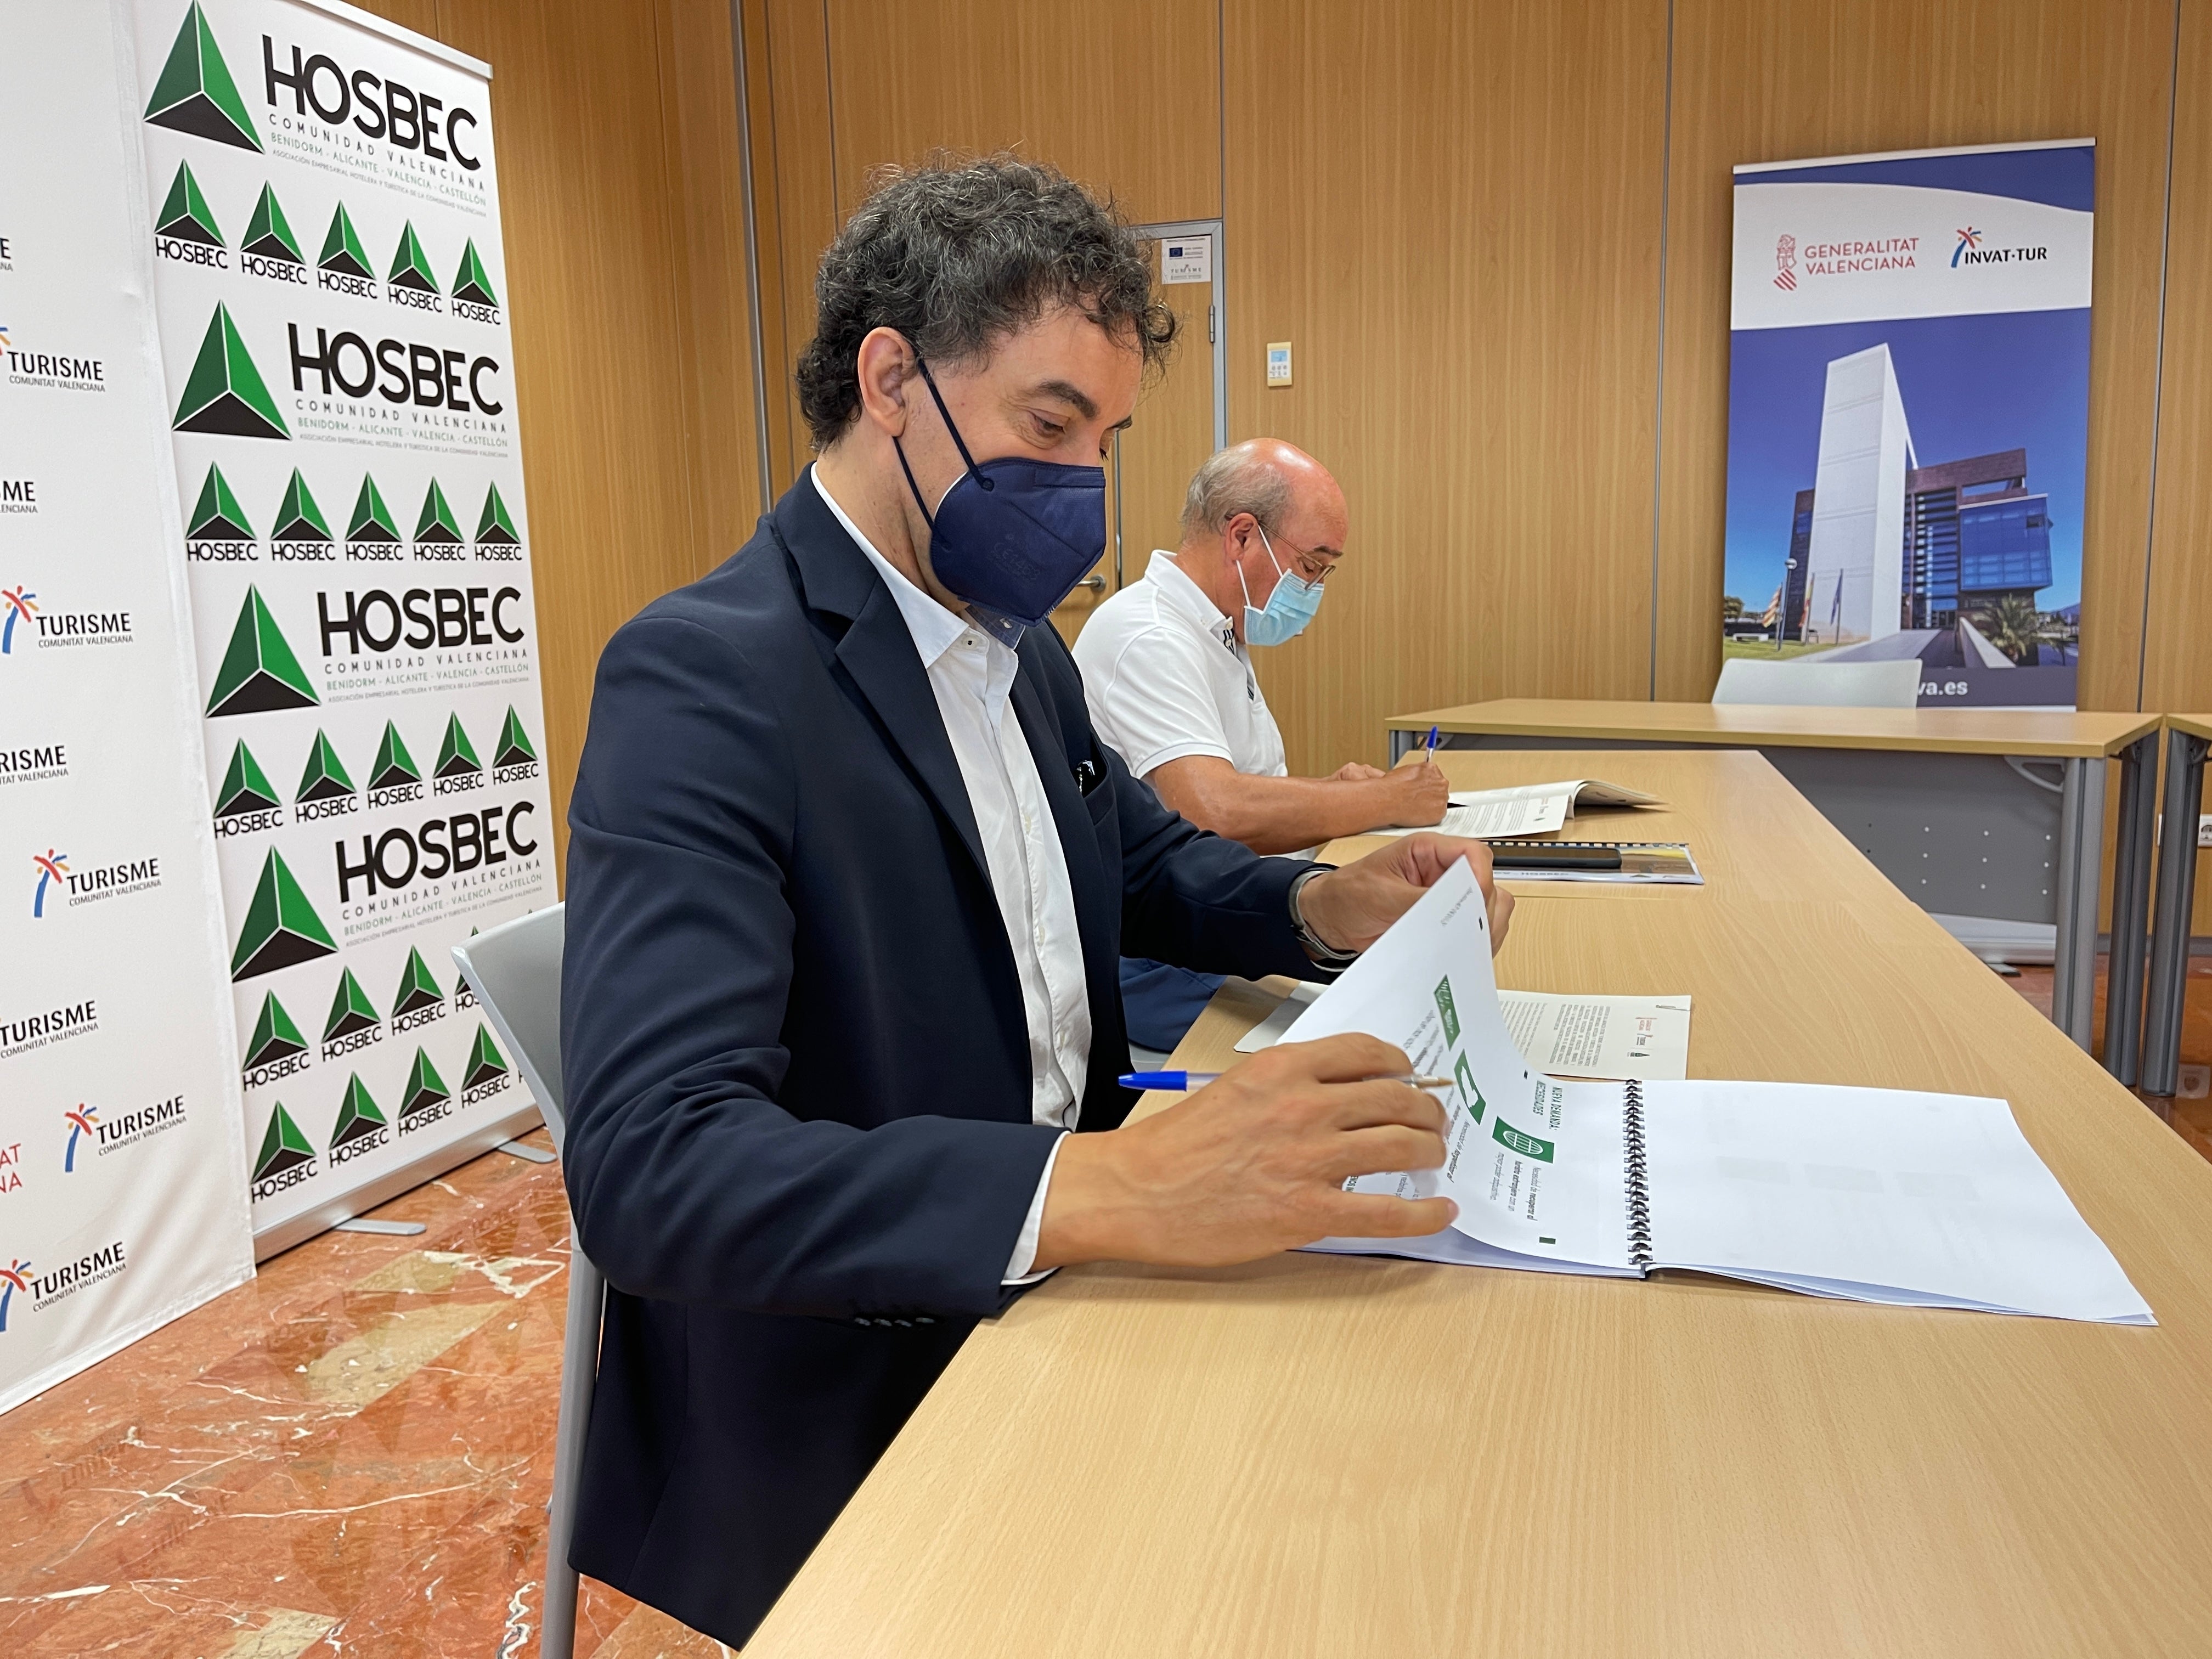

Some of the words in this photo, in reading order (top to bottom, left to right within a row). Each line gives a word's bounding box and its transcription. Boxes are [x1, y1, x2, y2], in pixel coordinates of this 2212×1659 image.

[262, 34, 481, 171] HOSBEC
[269, 114, 374, 155] COMUNIDAD
[387, 150, 484, 191] VALENCIANA
[271, 132, 323, 156] BENIDORM
[333, 151, 379, 173] ALICANTE
[387, 168, 431, 189] VALENCIA
[155, 237, 228, 269] HOSBEC
[1804, 237, 1919, 259] GENERALITAT
[241, 255, 307, 285] HOSBEC
[1806, 256, 1916, 275] VALENCIANA
[318, 272, 377, 299] HOSBEC
[388, 286, 442, 312] HOSBEC
[452, 301, 501, 325] HOSBEC
[7, 351, 104, 381] TURISME
[287, 322, 503, 415] HOSBEC
[9, 375, 55, 387] COMUNITAT
[296, 399, 399, 421] COMUNIDAD
[412, 412, 506, 433] VALENCIANA
[298, 417, 349, 431] BENIDORM
[359, 424, 403, 437] ALICANTE
[412, 429, 455, 442] VALENCIA
[0, 504, 38, 514] ENCIANA
[186, 543, 258, 561] HOSBEC
[271, 543, 336, 561] HOSBEC
[346, 543, 403, 561] HOSBEC
[414, 543, 466, 561] HOSBEC
[475, 543, 522, 561] HOSBEC
[36, 612, 131, 636] TURISME
[317, 586, 524, 656] HOSBEC
[38, 637, 83, 648] COMUNITAT
[325, 656, 424, 674] COMUNIDAD
[437, 649, 527, 664] VALENCIANA
[326, 678, 375, 691] BENIDORM
[386, 672, 427, 685] ALICANTE
[436, 668, 477, 679] VALENCIA
[0, 745, 66, 774] RISME
[433, 774, 484, 796] HOSBEC
[493, 763, 539, 785] HOSBEC
[295, 797, 358, 822] HOSBEC
[368, 785, 424, 809] HOSBEC
[214, 810, 284, 839] HOSBEC
[335, 801, 538, 904] HOSBEC
[67, 858, 160, 895] TURISME
[342, 886, 439, 919] COMUNIDAD
[452, 859, 540, 890] VALENCIANA
[69, 889, 114, 907] COMUNITAT
[344, 915, 392, 936] BENIDORM
[402, 900, 443, 918] ALICANTE
[452, 888, 491, 904] VALENCIA
[0, 1000, 97, 1046] TURISME
[392, 1003, 445, 1036] HOSBEC
[1, 1036, 48, 1059] COMUNITAT
[322, 1026, 382, 1062] HOSBEC
[243, 1051, 311, 1091] HOSBEC
[461, 1075, 510, 1108] HOSBEC
[1551, 1086, 1562, 1103] NUEVA
[96, 1094, 185, 1144] TURISME
[398, 1101, 452, 1137] HOSBEC
[1549, 1104, 1562, 1130] DEMANDA:
[99, 1133, 140, 1156] COMUNITAT
[330, 1128, 389, 1168] HOSBEC
[251, 1160, 318, 1204] HOSBEC
[31, 1241, 125, 1300] TURISME
[33, 1284, 77, 1312] COMUNITAT
